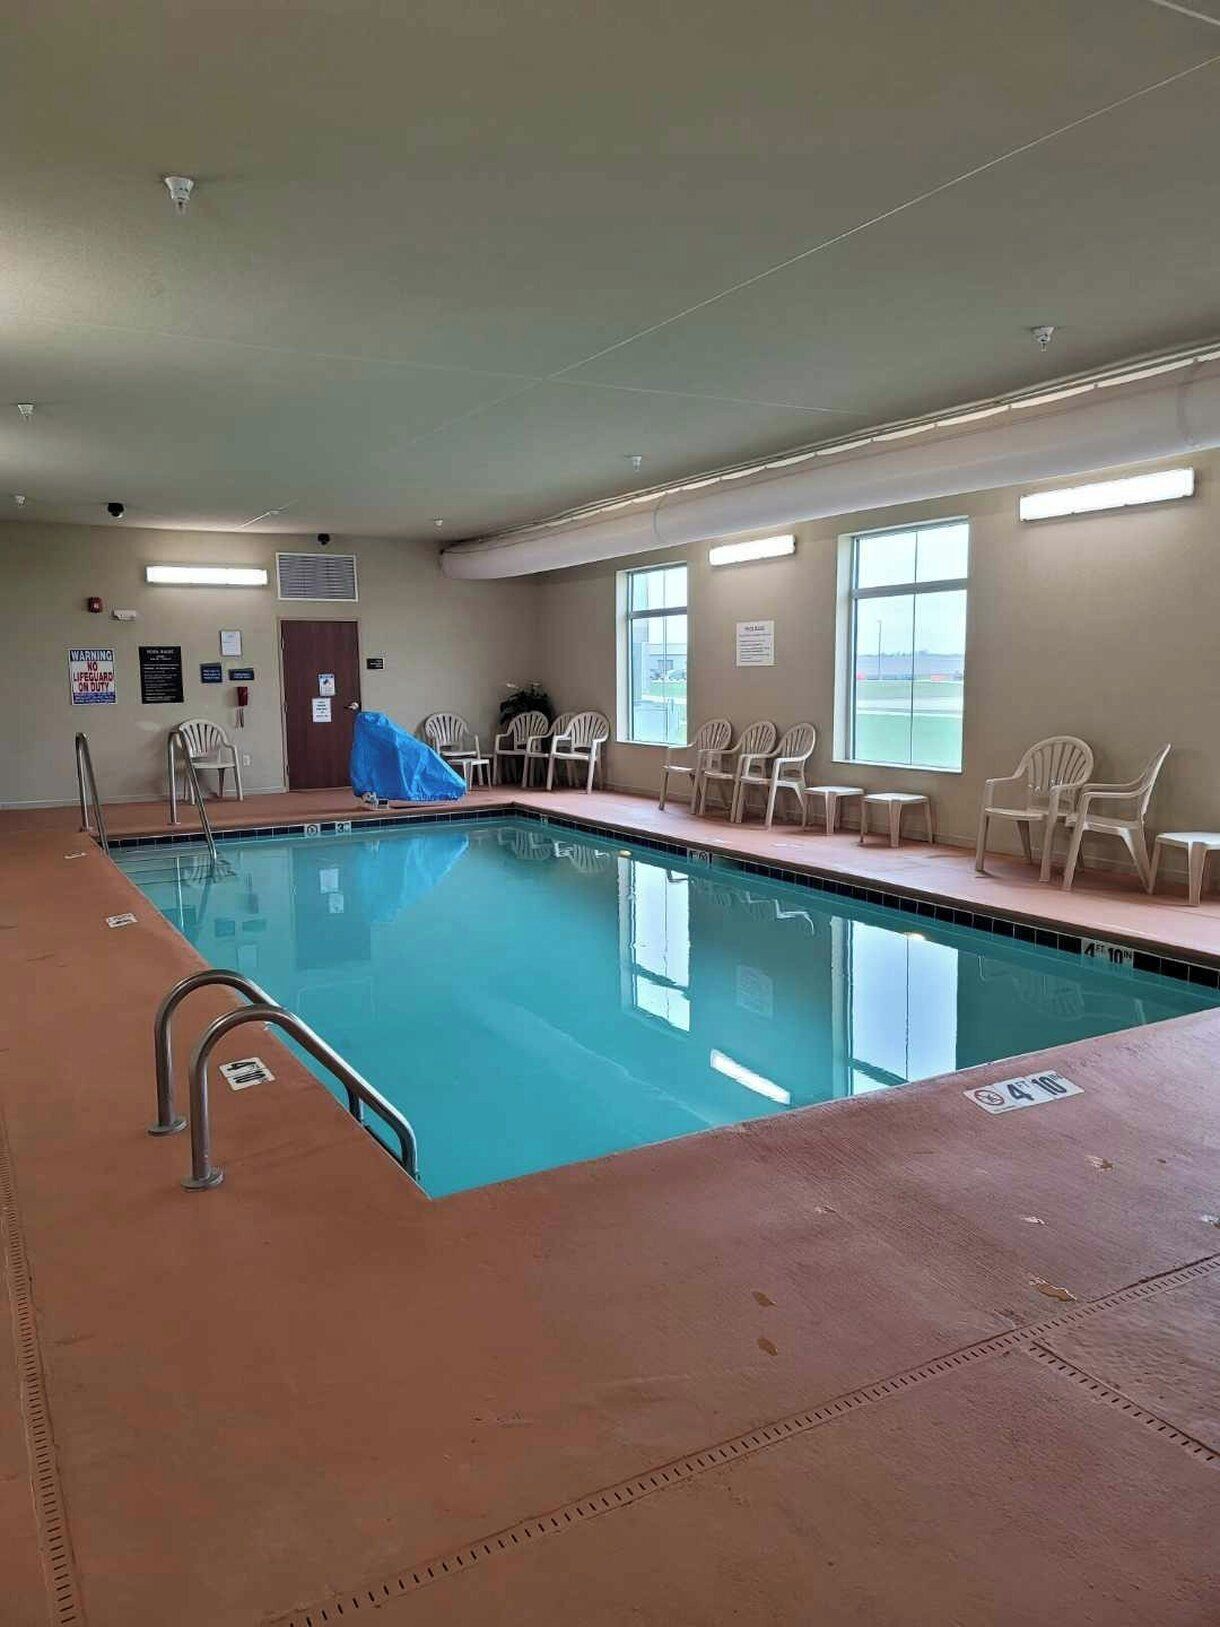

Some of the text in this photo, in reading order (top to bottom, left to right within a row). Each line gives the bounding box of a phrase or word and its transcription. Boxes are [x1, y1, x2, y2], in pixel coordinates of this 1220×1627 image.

[71, 650, 112, 660] WARNING
[87, 661, 98, 671] NO
[73, 672, 113, 682] LIFEGUARD
[79, 682, 109, 692] ON DUTY
